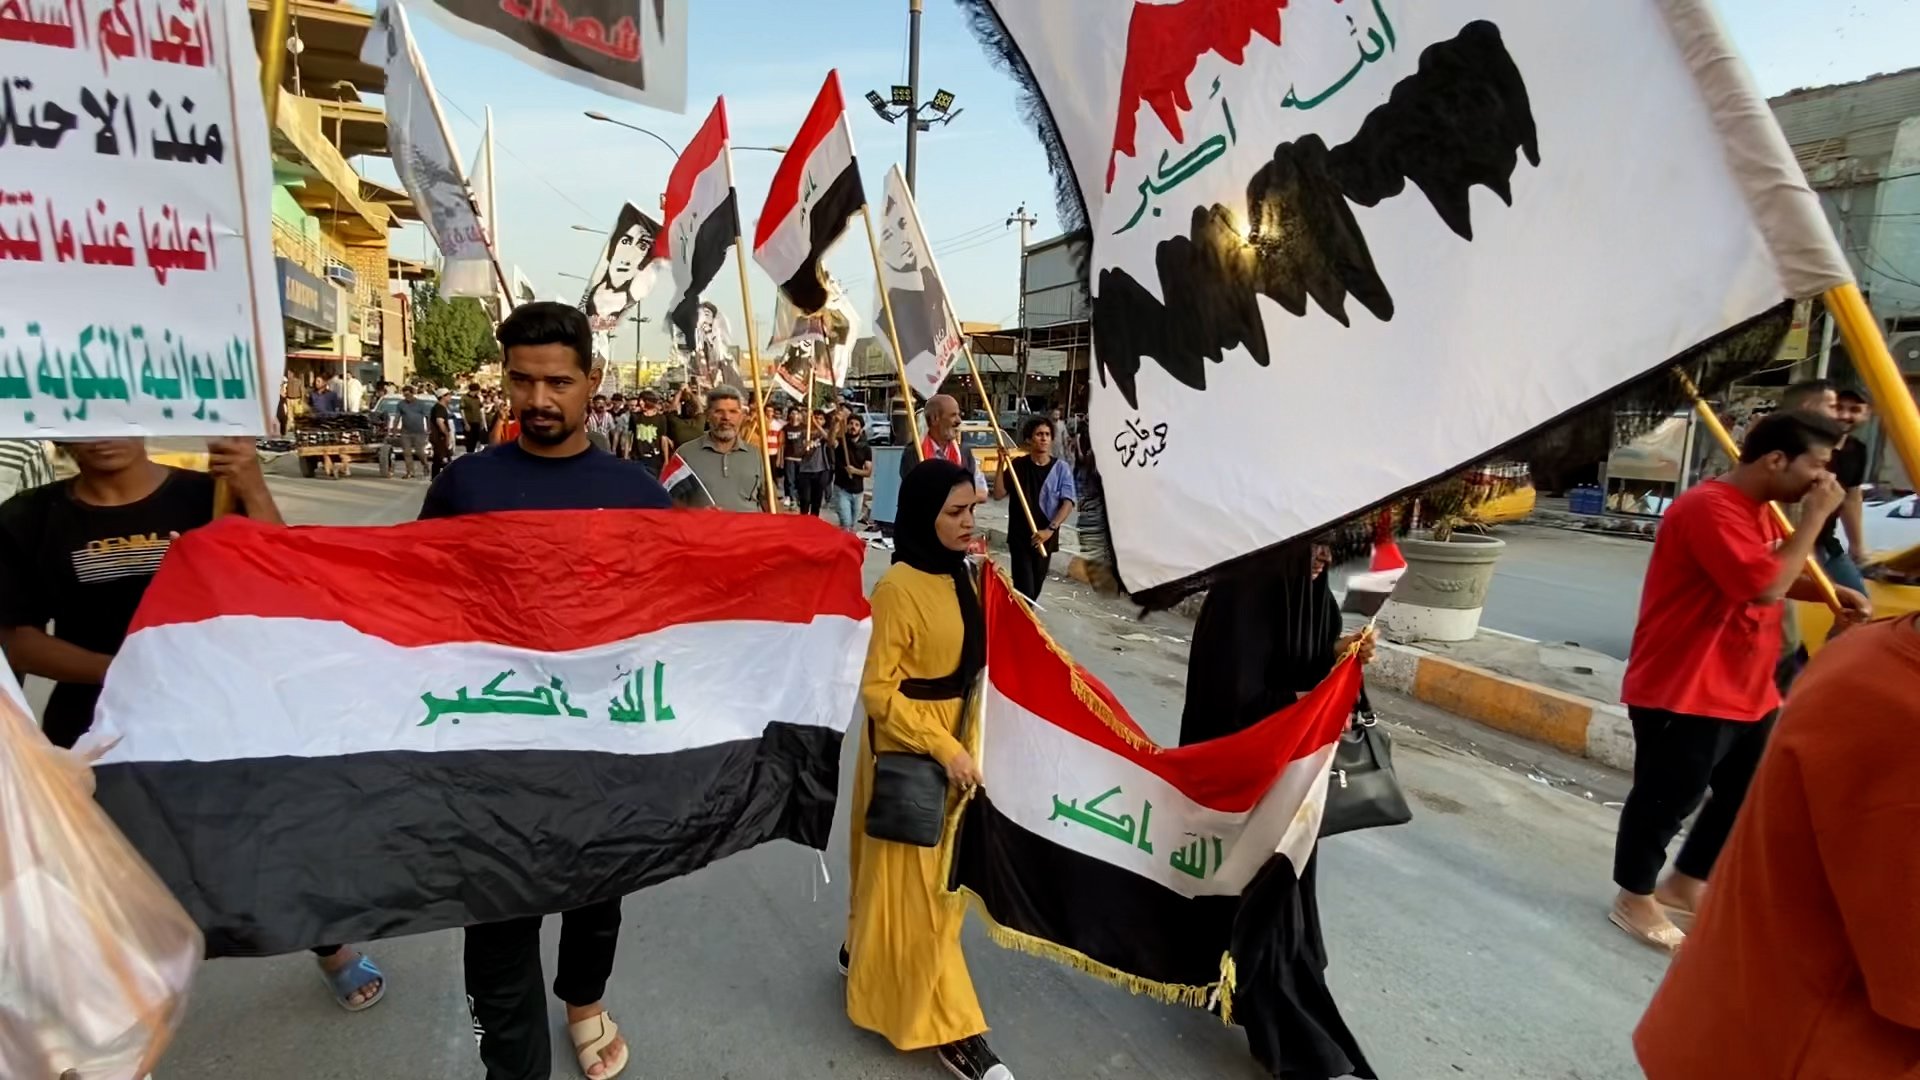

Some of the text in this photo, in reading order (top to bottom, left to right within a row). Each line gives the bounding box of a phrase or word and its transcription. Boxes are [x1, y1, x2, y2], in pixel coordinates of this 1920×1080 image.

[1280, 0, 1396, 110] الله
[148, 88, 223, 164] منذ
[607, 660, 676, 722] الله
[1169, 832, 1223, 880] الله
